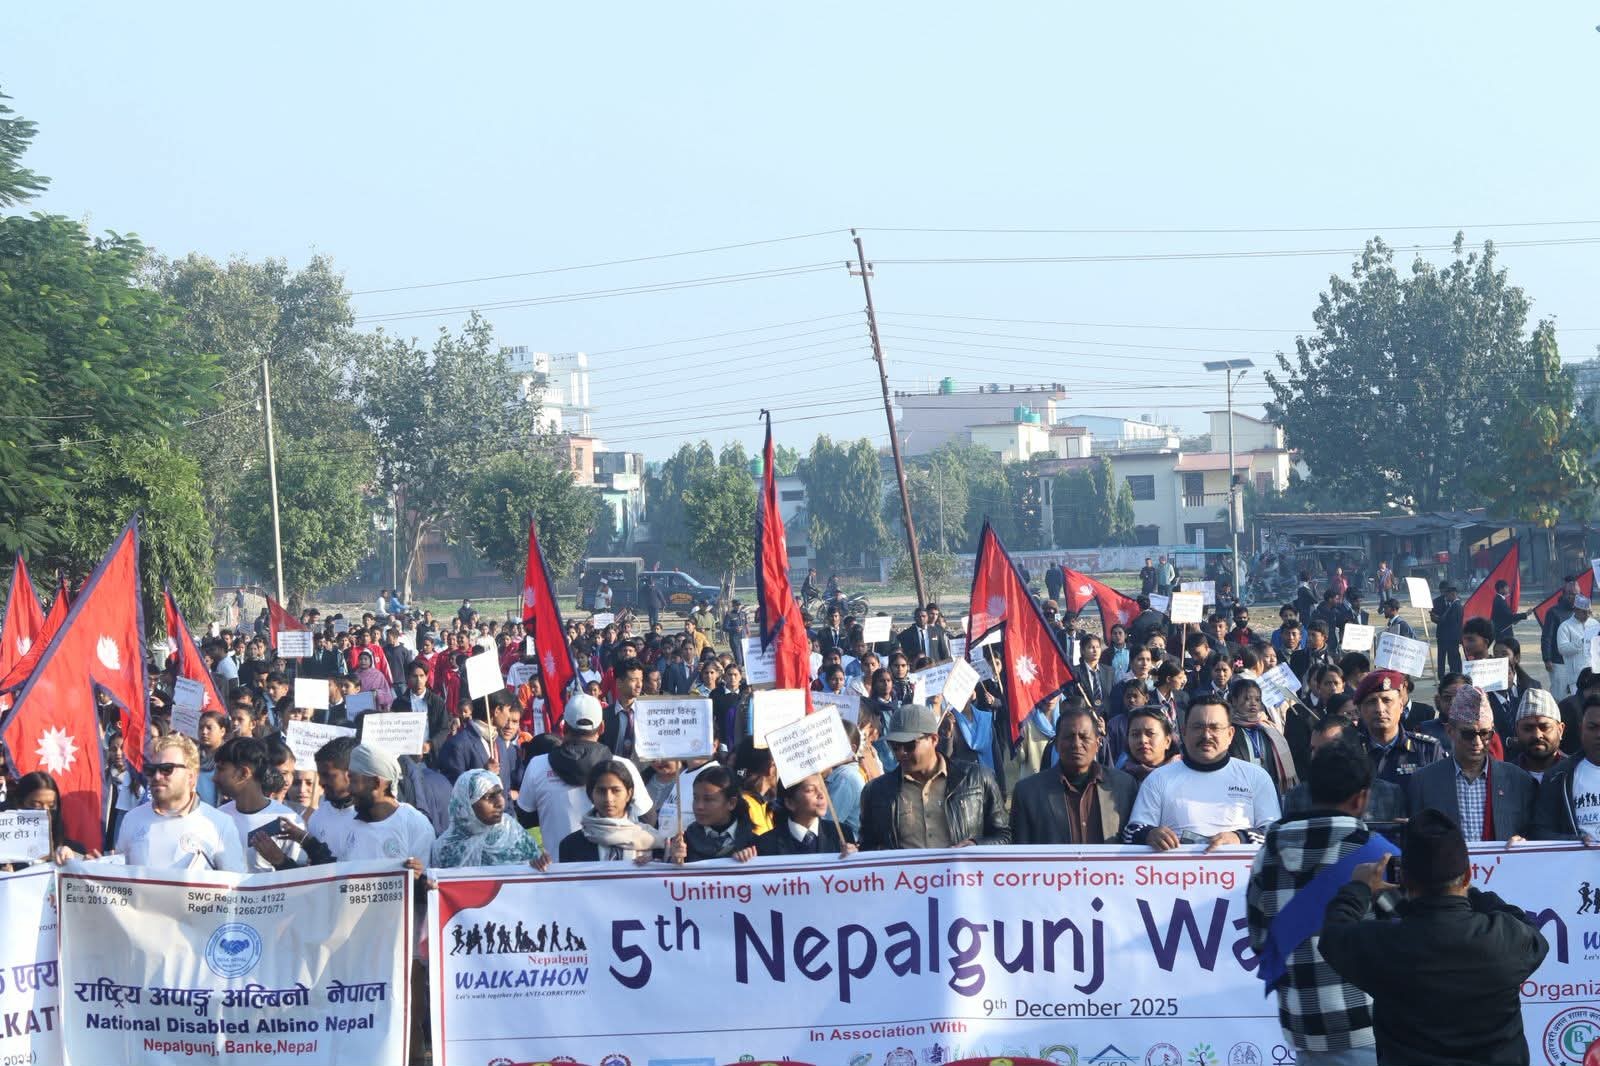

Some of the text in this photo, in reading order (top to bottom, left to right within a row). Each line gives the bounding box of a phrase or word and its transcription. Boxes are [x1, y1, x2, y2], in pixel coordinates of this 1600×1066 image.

[663, 879, 752, 903] 'Uniting
[762, 876, 810, 896] with
[820, 871, 884, 894] Youth
[894, 868, 984, 895] Against
[993, 867, 1124, 891] corruption:
[1135, 865, 1236, 891] Shaping
[88, 895, 108, 905] 2013
[187, 891, 211, 902] SWC
[188, 903, 214, 915] Regd
[528, 954, 588, 966] Nepalgunj
[733, 896, 1104, 1004] Nepalgunj
[455, 967, 589, 990] WALKATHON
[326, 979, 387, 1004] नेपाल
[1015, 999, 1122, 1018] December
[1130, 998, 1179, 1017] 2025
[86, 1013, 374, 1034] National Disabled Albino Nepal
[810, 1020, 968, 1042] In Association With
[143, 1038, 220, 1057] Nepalgunj,
